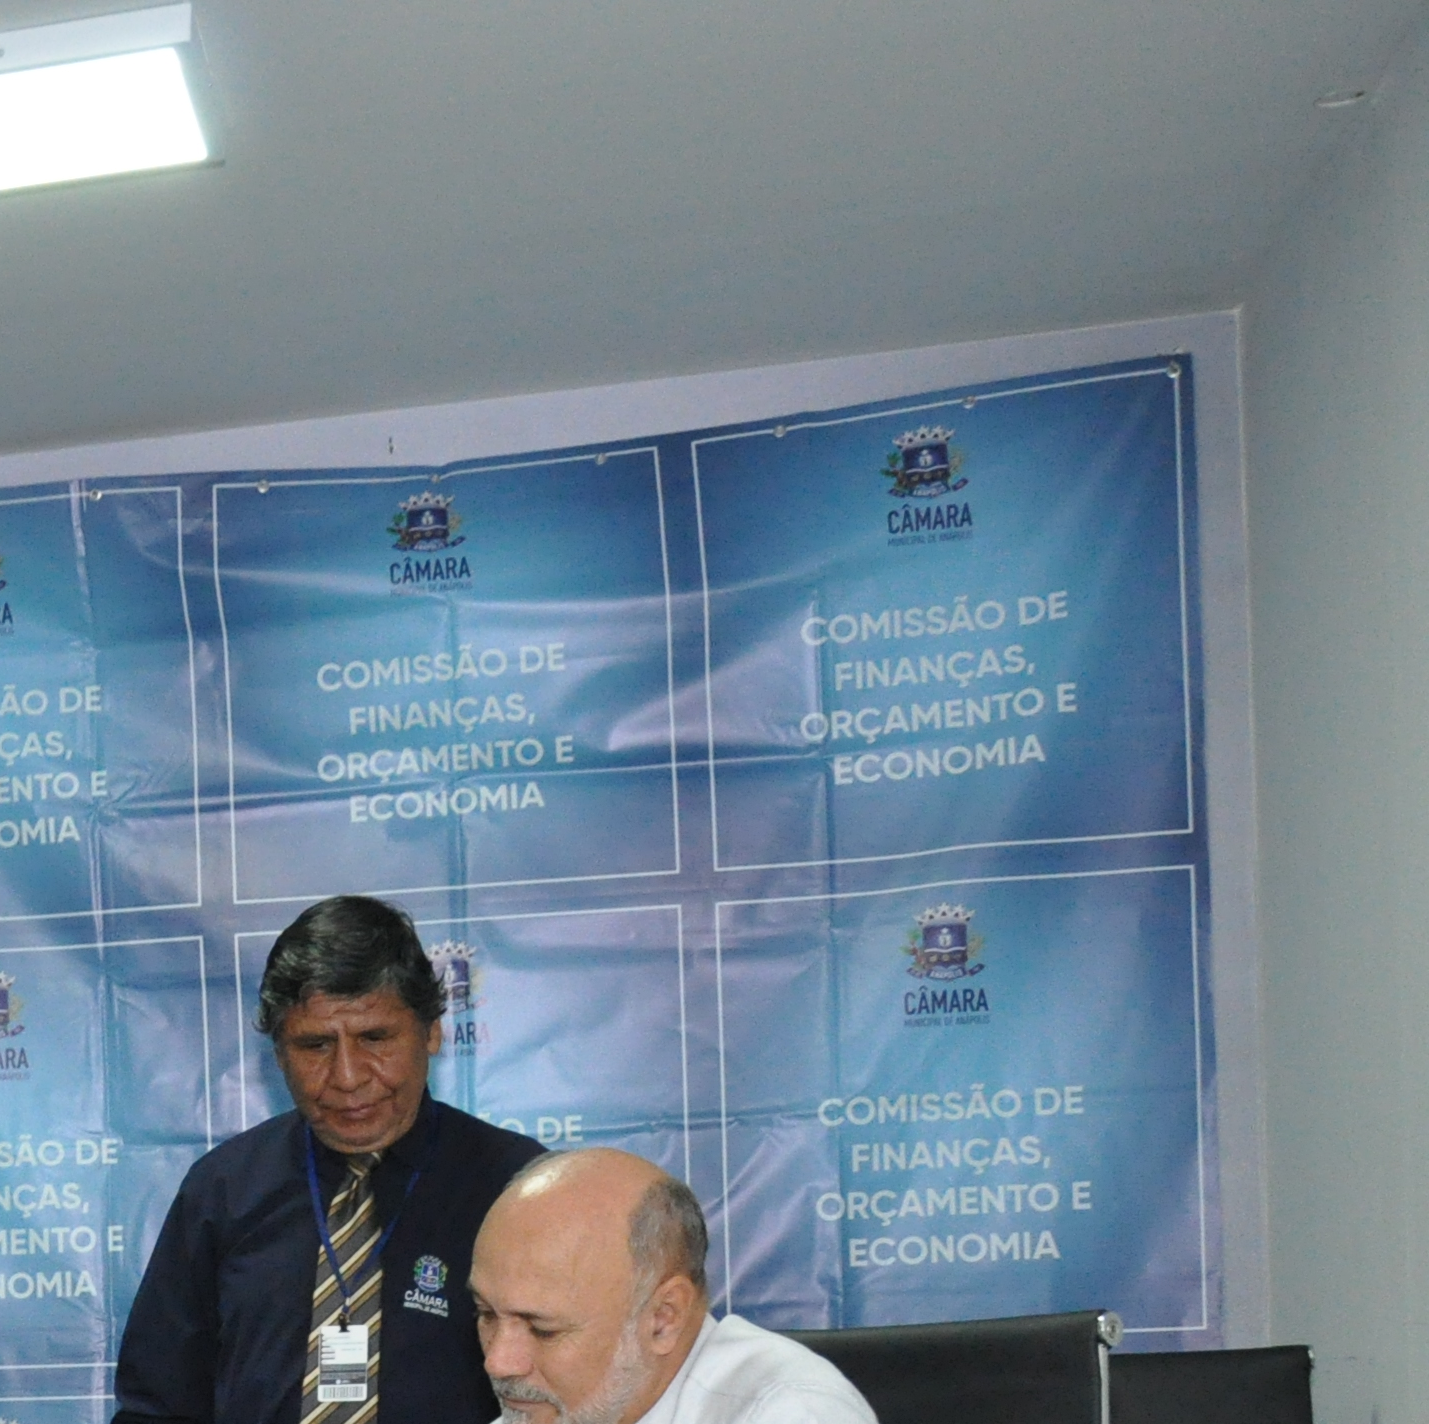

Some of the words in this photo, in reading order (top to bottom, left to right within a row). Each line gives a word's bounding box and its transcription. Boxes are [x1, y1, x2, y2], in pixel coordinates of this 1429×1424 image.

[887, 502, 973, 534] CÂMARA
[389, 556, 471, 585] CÂMARA
[800, 595, 1006, 646] COMISSÃO
[1017, 590, 1068, 626] DE
[317, 643, 508, 692] COMISSÃO
[519, 642, 565, 674] DE
[834, 645, 1035, 692] FINANÇAS,
[59, 686, 102, 714] DE
[349, 693, 535, 735] FINANÇAS,
[800, 687, 1045, 744] ORÇAMENTO
[1056, 682, 1078, 713] E
[317, 738, 545, 784] ORÇAMENTO
[555, 735, 574, 763] E
[833, 734, 1045, 785] ECONOMIA
[91, 770, 108, 797] E
[350, 782, 545, 823] ECONOMIA
[904, 985, 989, 1015] CÂMARA
[817, 1083, 1022, 1127] COMISSÃO
[1034, 1086, 1084, 1116] DE
[537, 1114, 583, 1143] DE
[75, 1138, 118, 1166] DE
[851, 1136, 1051, 1175] FINANÇAS,
[816, 1182, 1059, 1226] ORÇAMENTO
[1072, 1181, 1092, 1211] E
[108, 1225, 124, 1252] E
[849, 1230, 1060, 1267] ECONOMIA
[404, 1288, 448, 1310] CÂMARA
